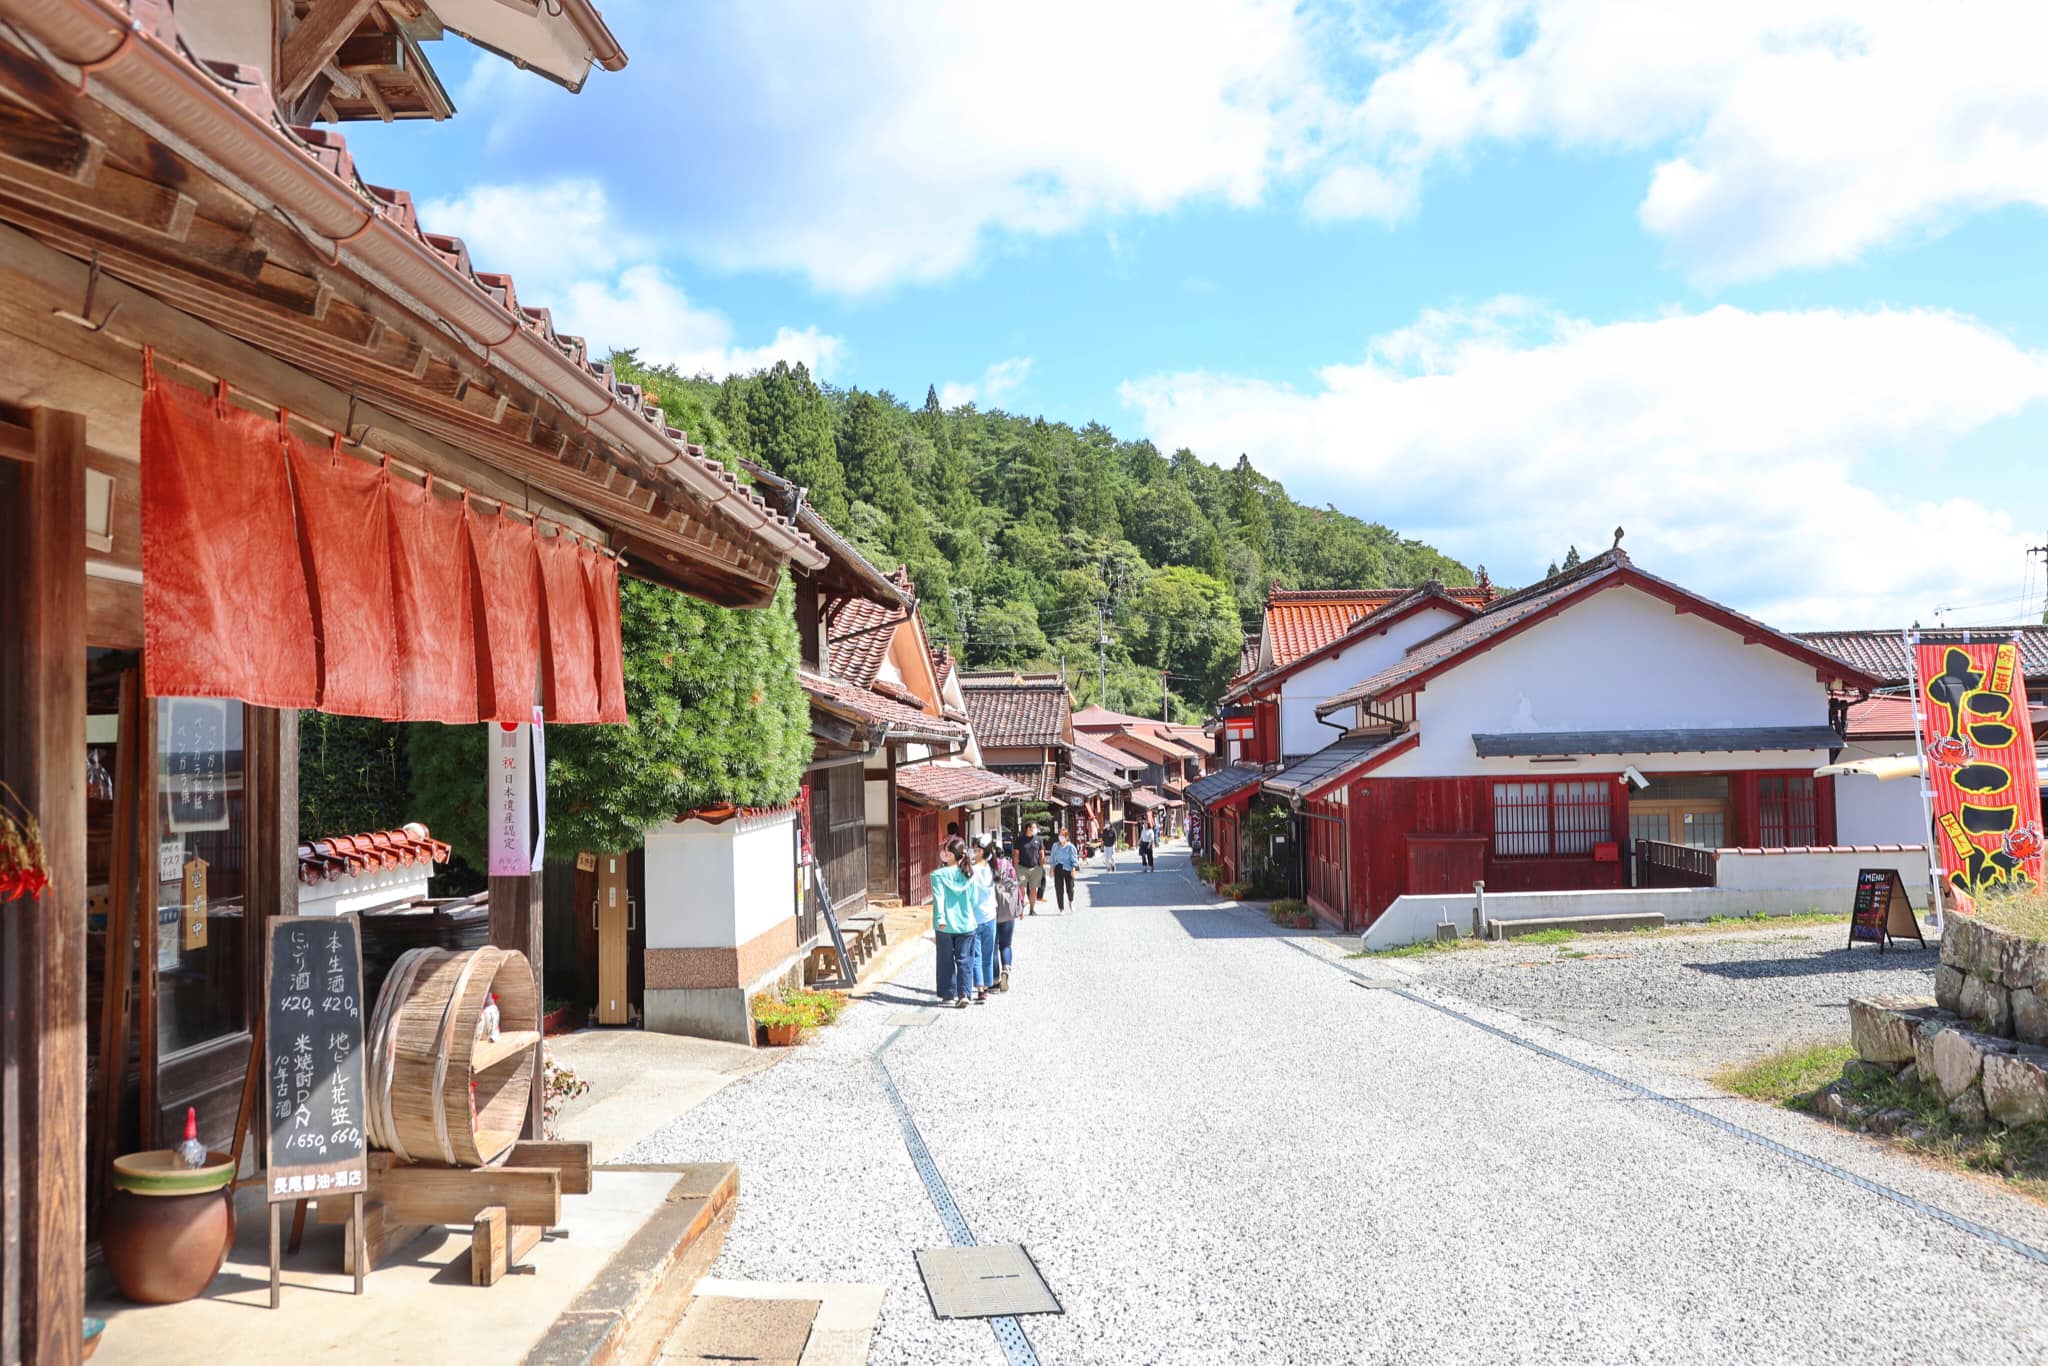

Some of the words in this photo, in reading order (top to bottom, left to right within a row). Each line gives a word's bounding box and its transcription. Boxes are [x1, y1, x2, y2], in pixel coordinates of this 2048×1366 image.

[502, 757, 517, 770] 祝
[503, 773, 515, 851] 日本遺産認定
[191, 870, 202, 937] 営業中
[1865, 873, 1885, 882] MENU
[289, 931, 311, 991] にごり酒
[325, 930, 345, 993] 本生酒
[281, 996, 314, 1018] 420円
[322, 995, 358, 1018] 420円
[273, 1055, 292, 1119] 10年古酒
[328, 1032, 353, 1127] 地ビール花笠
[330, 1128, 363, 1149] 660円
